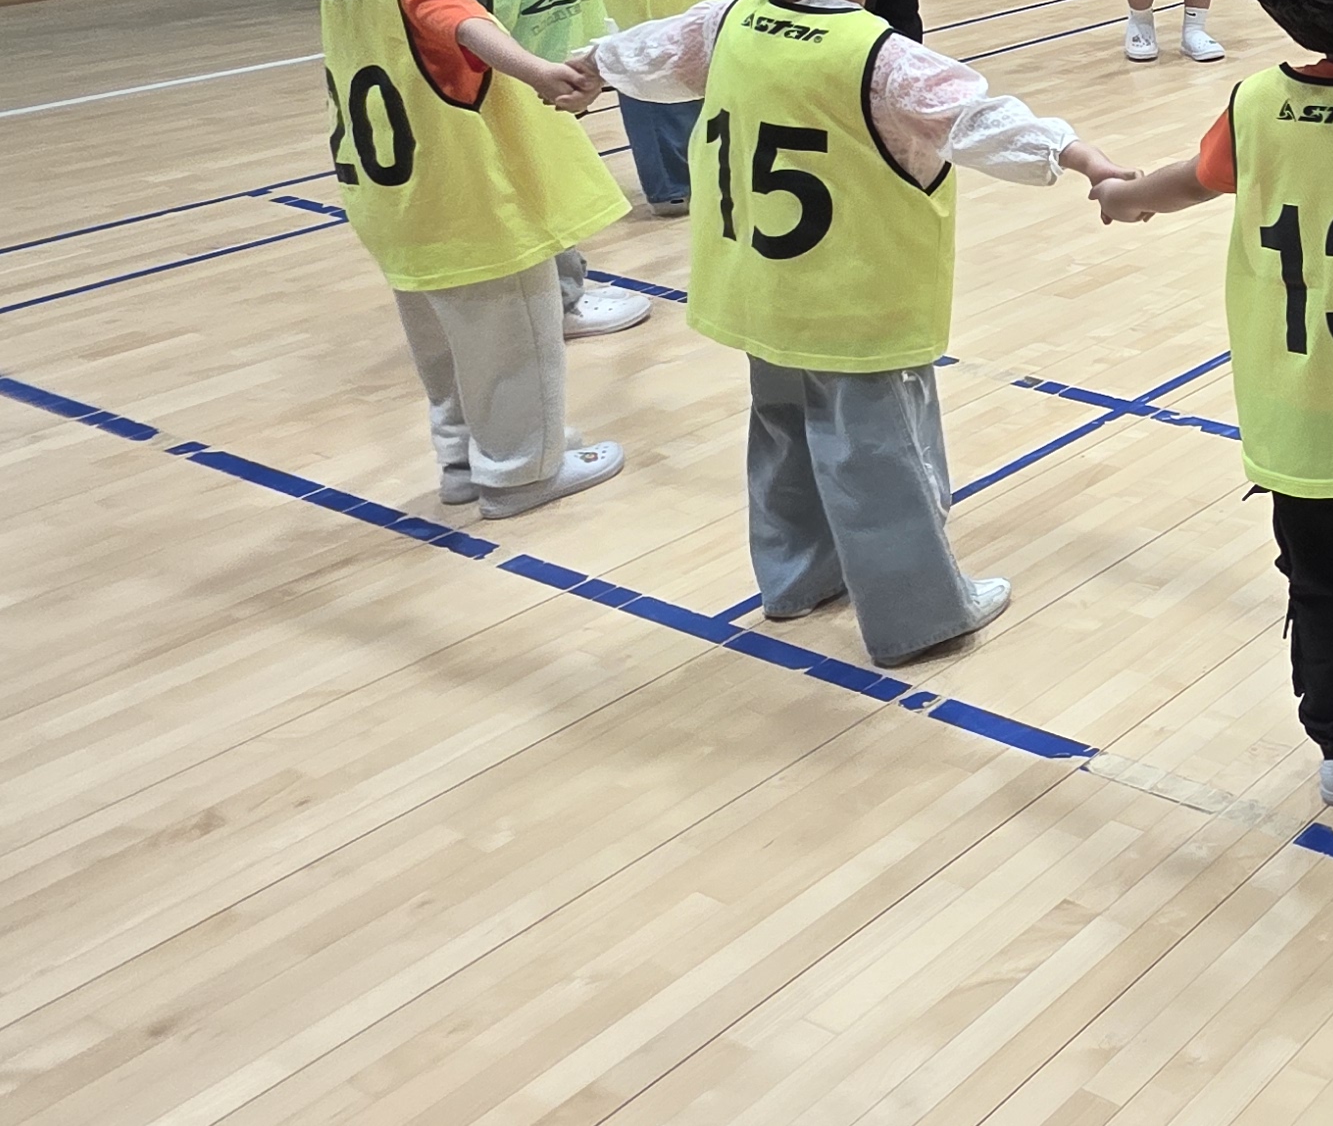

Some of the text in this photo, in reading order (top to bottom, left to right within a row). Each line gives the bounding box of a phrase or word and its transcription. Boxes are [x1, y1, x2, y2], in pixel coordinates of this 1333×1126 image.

[753, 17, 829, 43] star
[325, 64, 416, 186] 20
[706, 108, 833, 260] 15
